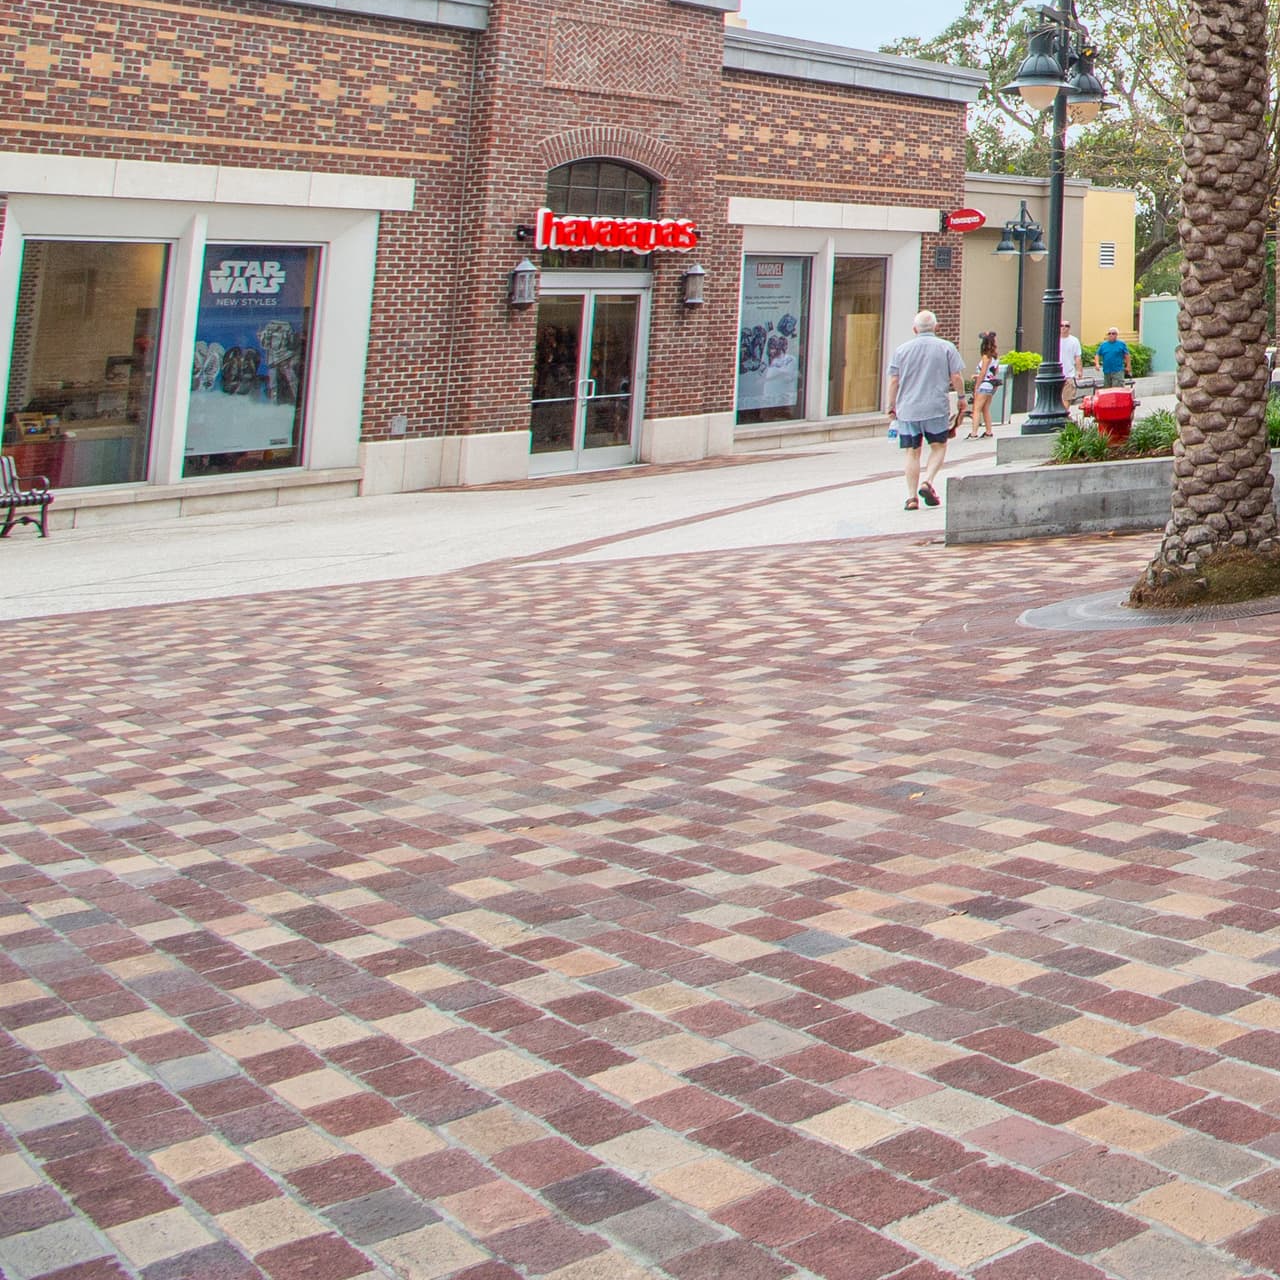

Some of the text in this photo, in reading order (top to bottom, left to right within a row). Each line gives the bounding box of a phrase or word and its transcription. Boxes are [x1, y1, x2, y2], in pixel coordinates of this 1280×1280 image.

[208, 260, 287, 277] STAR
[208, 276, 287, 294] WARS
[215, 297, 278, 306] NEW STYLES
